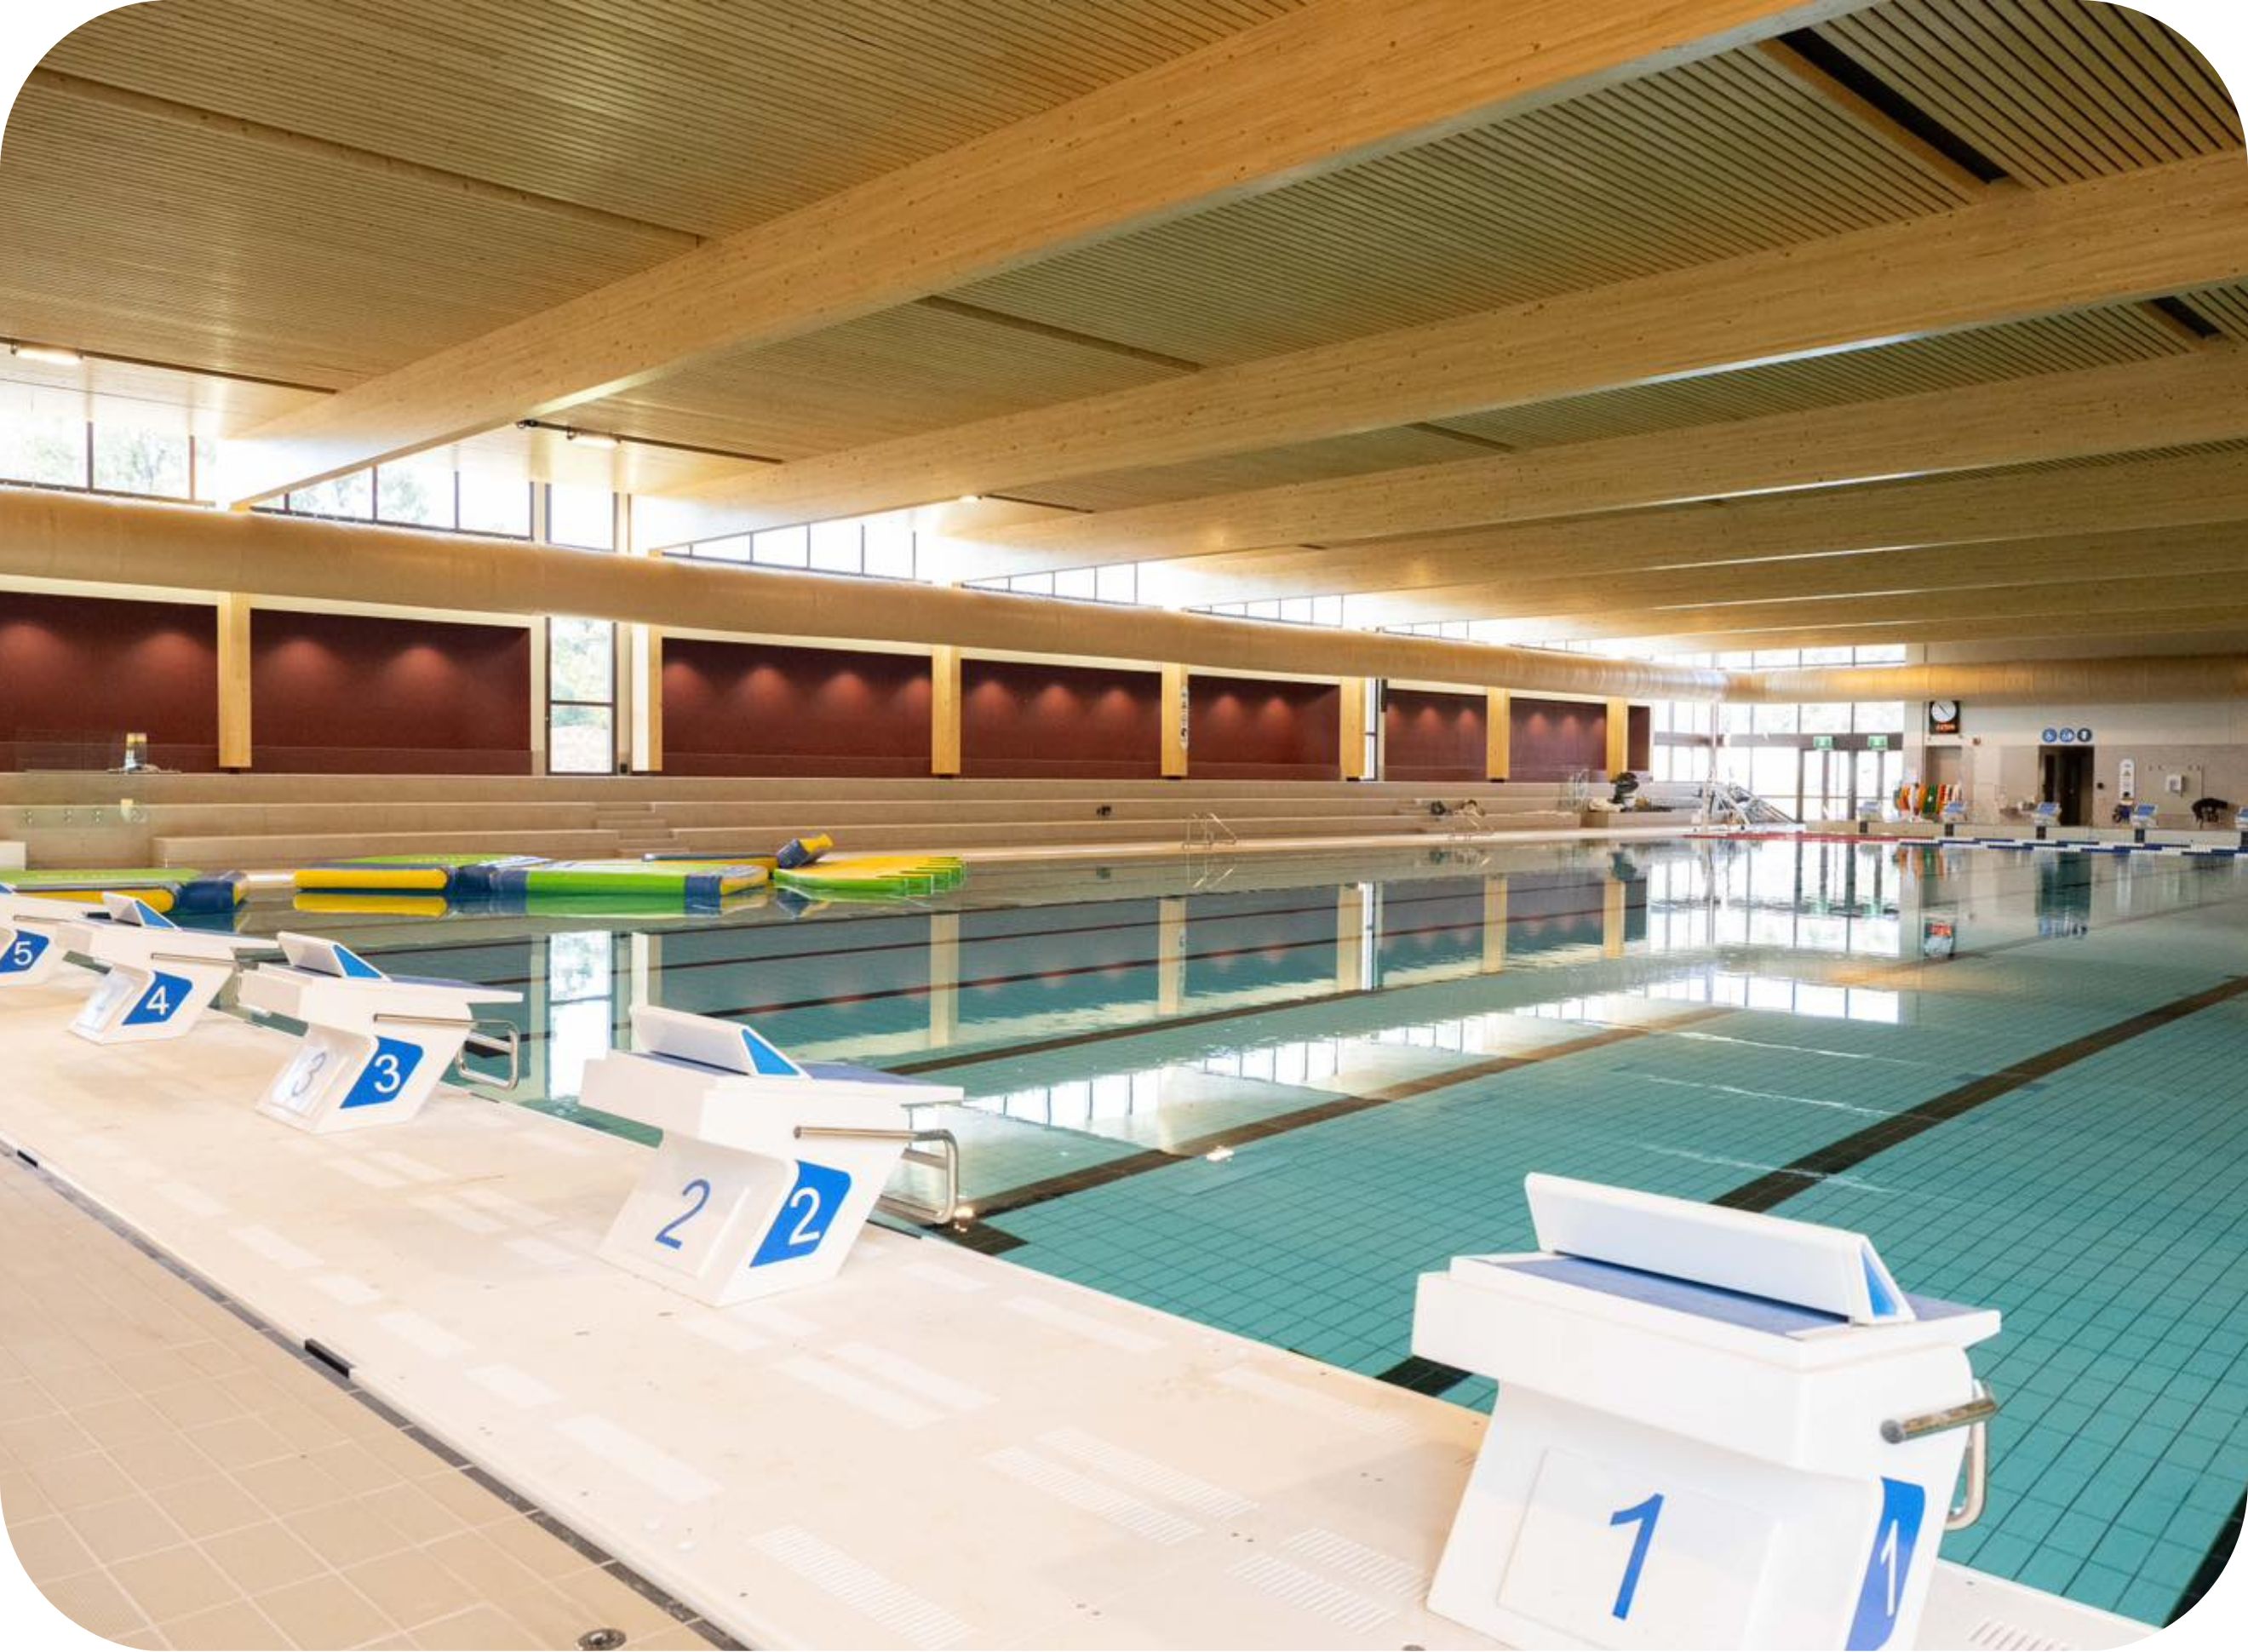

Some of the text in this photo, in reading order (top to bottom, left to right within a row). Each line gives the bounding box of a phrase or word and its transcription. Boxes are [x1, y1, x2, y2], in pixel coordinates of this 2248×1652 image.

[13, 940, 33, 967] 5
[146, 984, 170, 1016] 4
[291, 1052, 328, 1097] 3
[374, 1053, 401, 1094] 3
[654, 1179, 711, 1250] 2
[789, 1186, 821, 1247] 2
[1609, 1492, 1665, 1621] 1
[1879, 1520, 1897, 1616] 1
